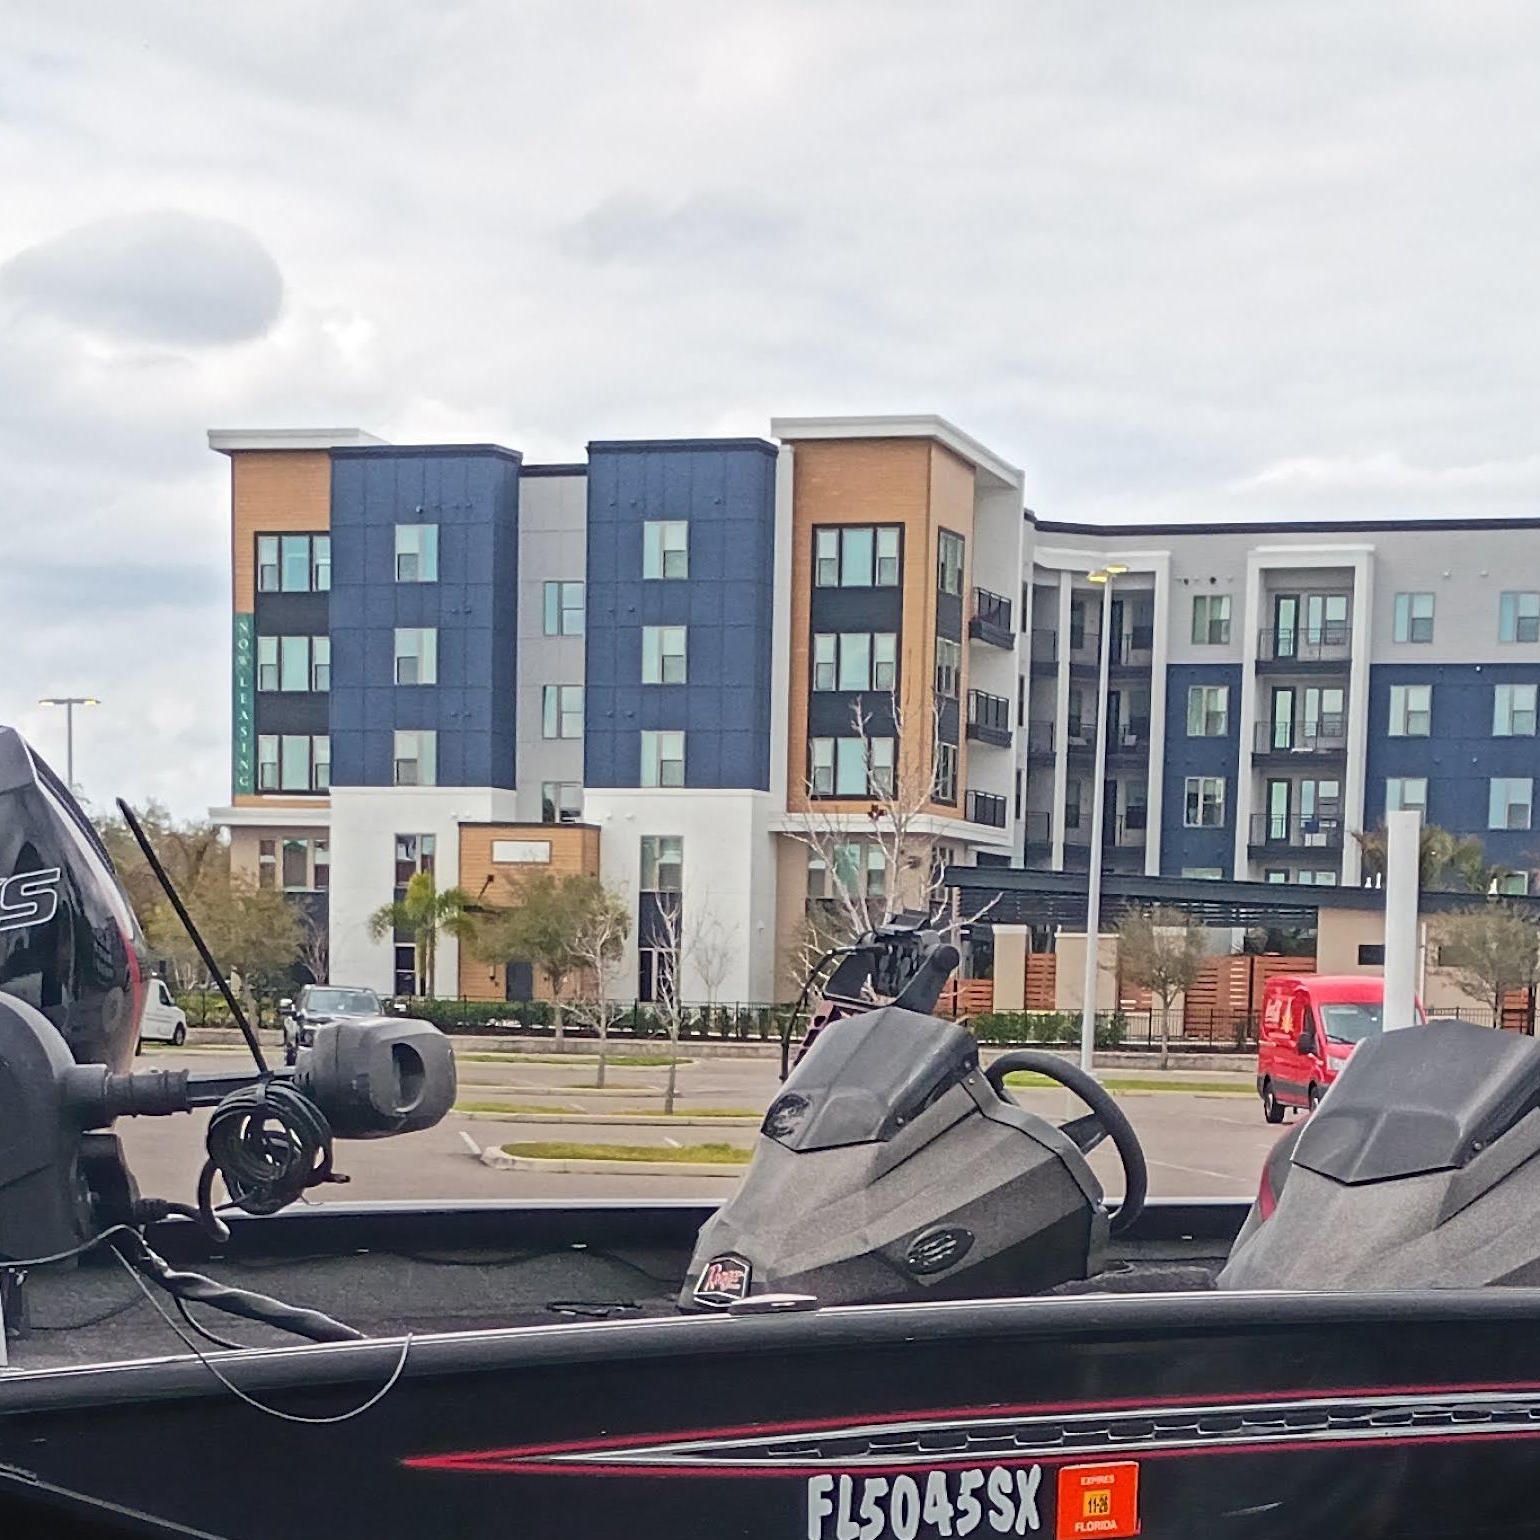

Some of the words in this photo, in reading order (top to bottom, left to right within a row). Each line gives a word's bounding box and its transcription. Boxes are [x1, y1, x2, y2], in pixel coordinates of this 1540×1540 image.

[238, 621, 250, 666] NOW
[238, 676, 250, 787] LEASING
[1074, 1520, 1118, 1533] FLORIDA
